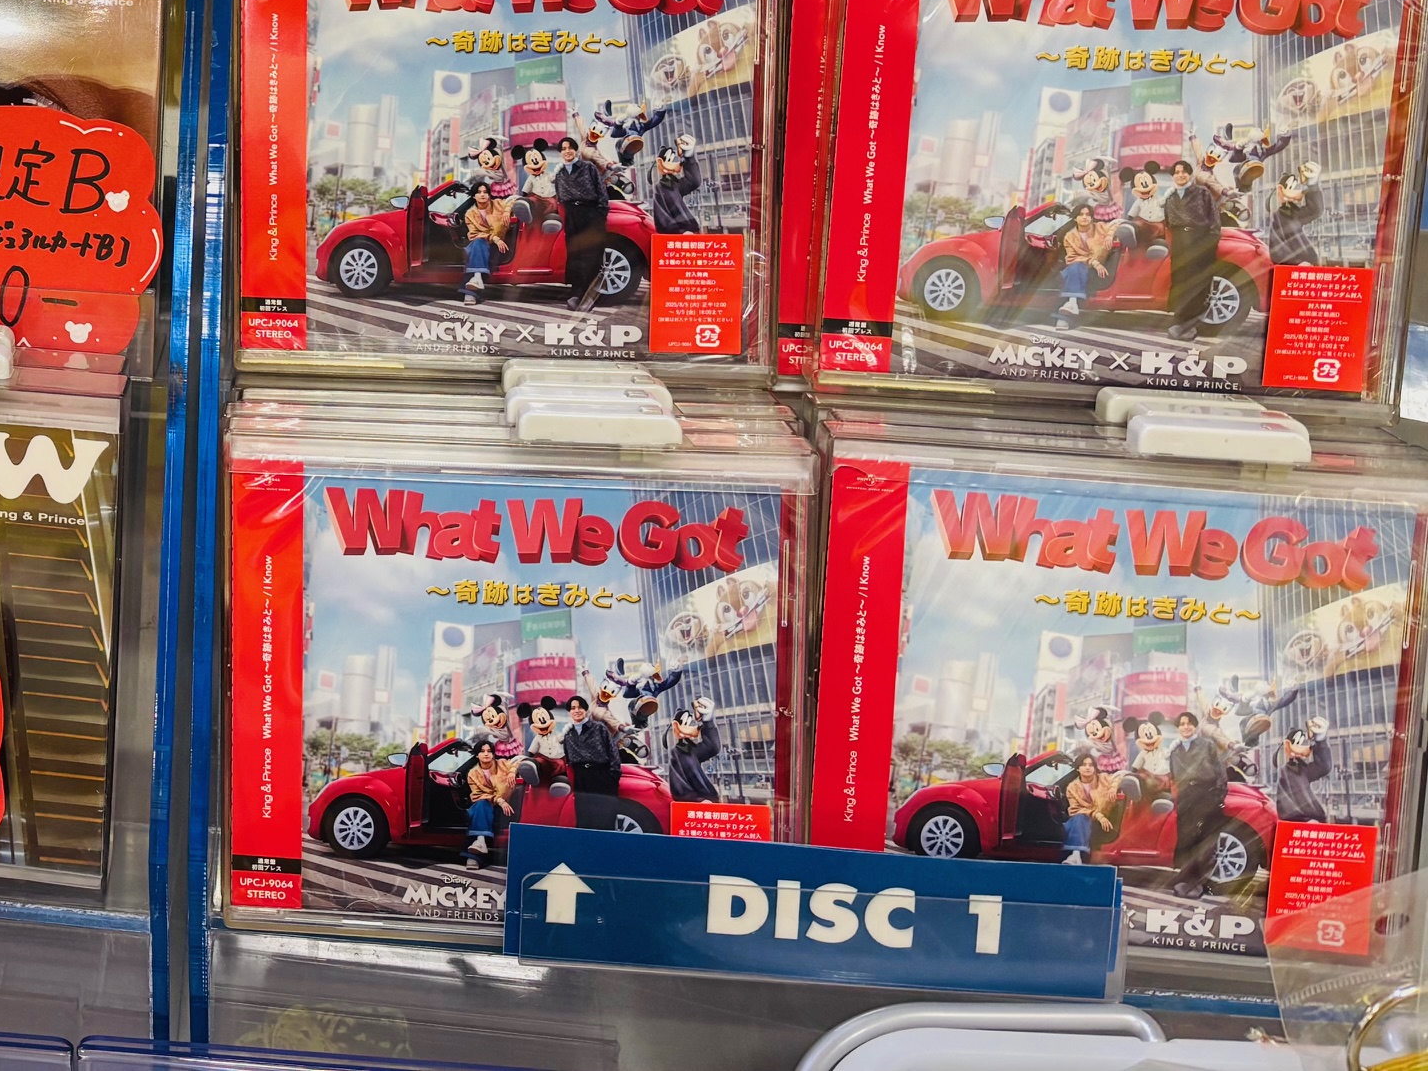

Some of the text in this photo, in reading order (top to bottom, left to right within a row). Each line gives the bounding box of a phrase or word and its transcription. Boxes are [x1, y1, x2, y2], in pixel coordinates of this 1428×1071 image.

[248, 318, 299, 328] UPCJ-9064
[255, 329, 292, 339] STEREO
[403, 320, 507, 343] MICKEY
[550, 348, 636, 359] KING PRINCE
[987, 343, 1101, 370] MICKEY
[1146, 377, 1178, 387] KING
[22, 508, 33, 521] &
[37, 511, 86, 526] Prince
[324, 486, 750, 573] What We Got
[930, 489, 1380, 591] What We Got
[240, 877, 293, 889] UPCJ-9064
[247, 889, 286, 900] STEREO
[705, 875, 1004, 955] DISC 1
[1152, 936, 1247, 952] KING PRINCE
